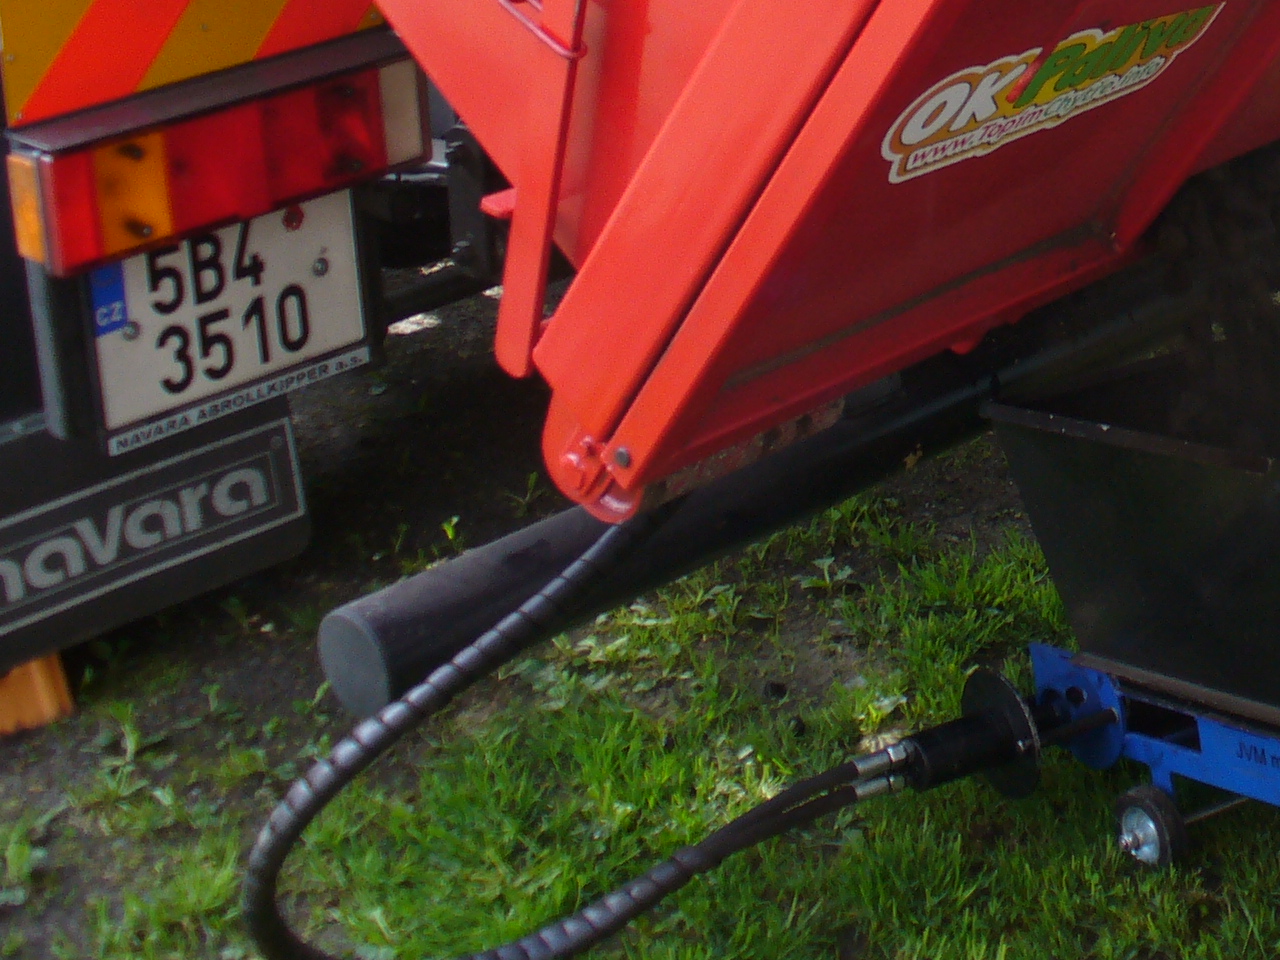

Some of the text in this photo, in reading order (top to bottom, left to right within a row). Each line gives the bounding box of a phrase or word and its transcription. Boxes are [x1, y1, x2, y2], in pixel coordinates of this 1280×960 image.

[900, 4, 1216, 145] OK Paliva
[94, 300, 125, 328] CZ
[144, 220, 266, 316] 5B4
[155, 284, 310, 395] 3510
[114, 351, 364, 450] NAVARA ABROLLKIPPER a.s.
[0, 467, 268, 602] navara
[1235, 741, 1268, 766] JVM
